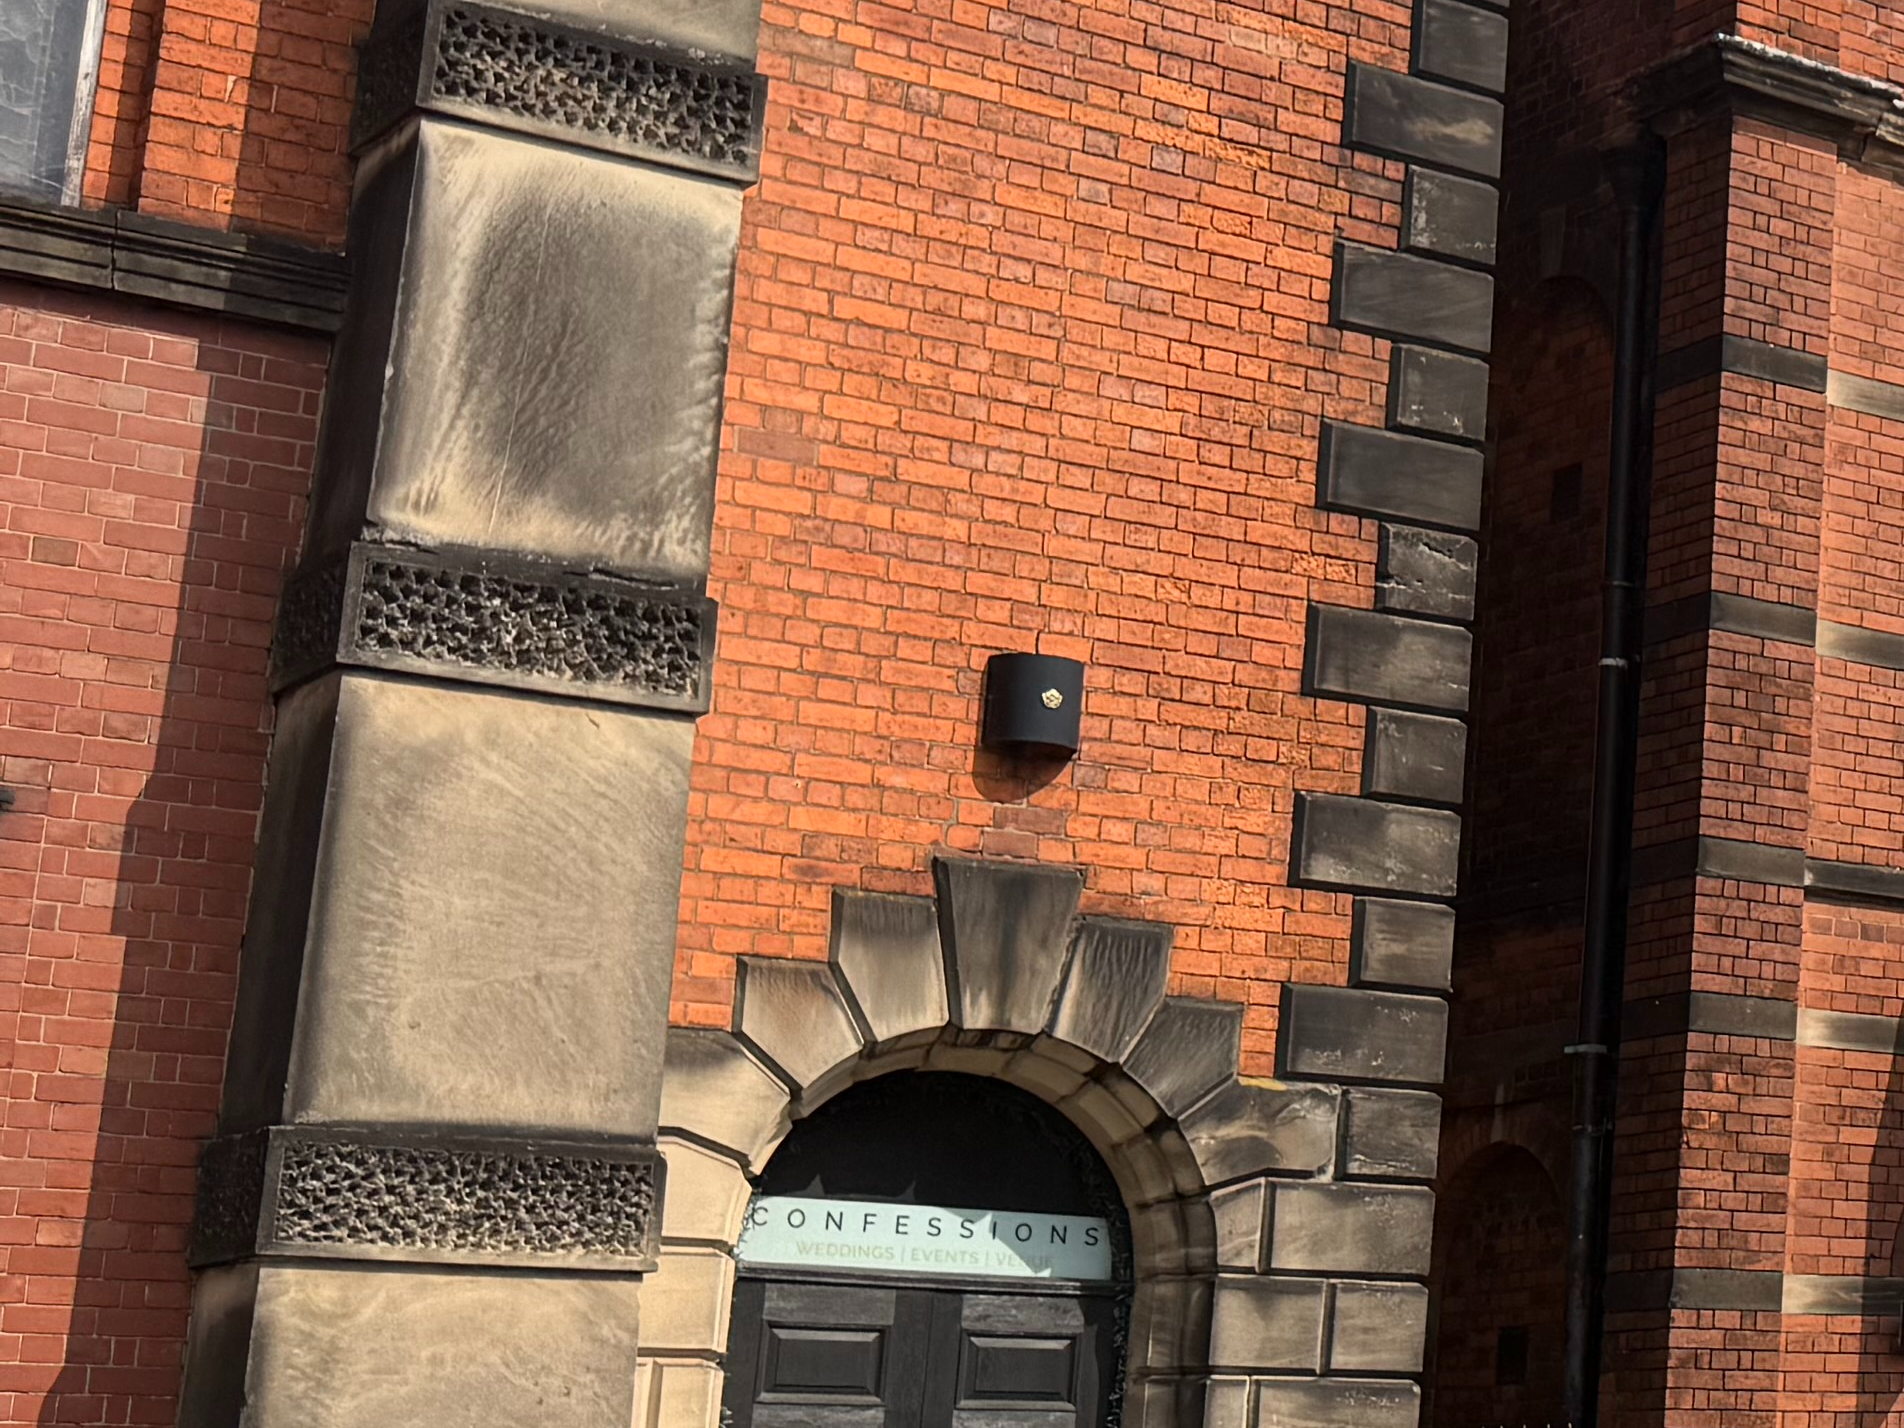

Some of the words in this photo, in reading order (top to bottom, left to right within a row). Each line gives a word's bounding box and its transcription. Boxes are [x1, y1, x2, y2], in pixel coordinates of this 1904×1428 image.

[750, 1207, 1100, 1247] CONFESSIONS
[795, 1240, 895, 1262] WEDDINGS
[911, 1246, 979, 1265] EVENTS
[996, 1251, 1054, 1269] VENUE
